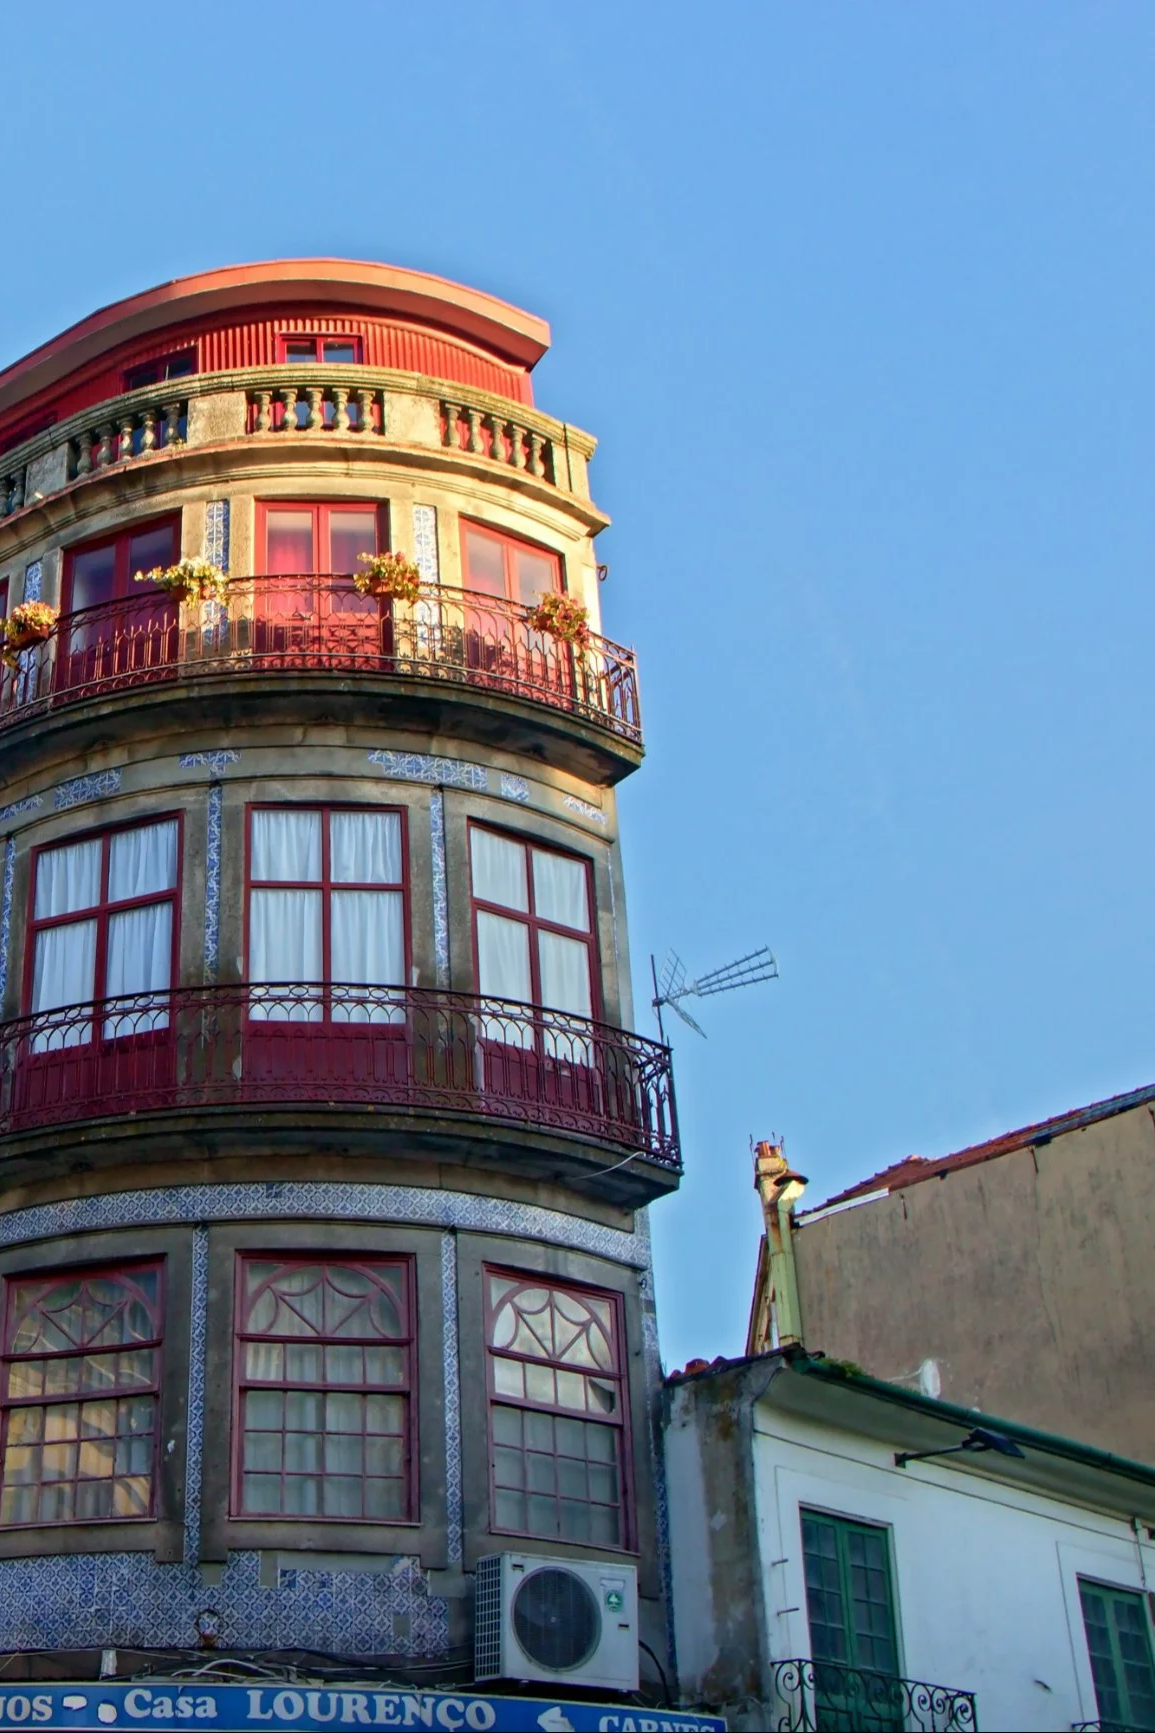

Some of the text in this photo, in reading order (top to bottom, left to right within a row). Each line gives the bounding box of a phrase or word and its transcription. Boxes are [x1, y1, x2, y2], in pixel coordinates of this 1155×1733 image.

[123, 1688, 218, 1719] Casa
[246, 1689, 496, 1732] LOURENÇO
[598, 1716, 715, 1732] CAR
